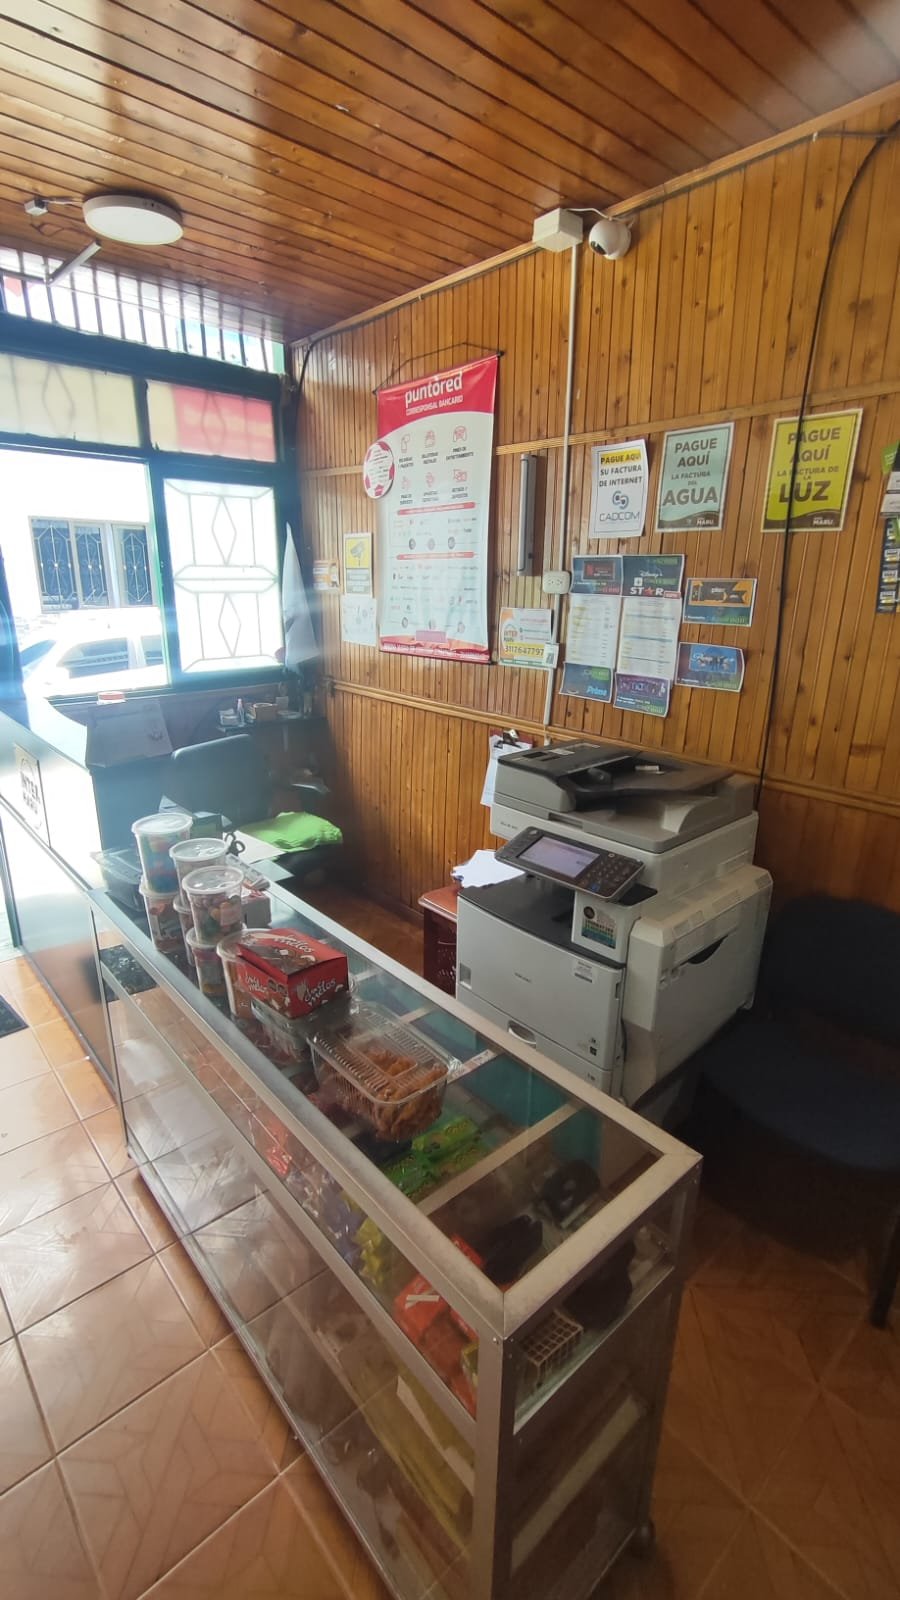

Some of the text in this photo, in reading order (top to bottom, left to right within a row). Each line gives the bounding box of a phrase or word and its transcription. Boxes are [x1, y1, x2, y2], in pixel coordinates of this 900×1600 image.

[405, 371, 463, 408] puntored
[674, 438, 718, 454] PAGUE
[600, 455, 624, 464] PAGUE
[677, 451, 710, 468] AQUÍ
[611, 464, 642, 474] FACTURA
[610, 476, 642, 486] INTERNET
[662, 486, 718, 506] AGUA
[778, 480, 831, 503] LUZ
